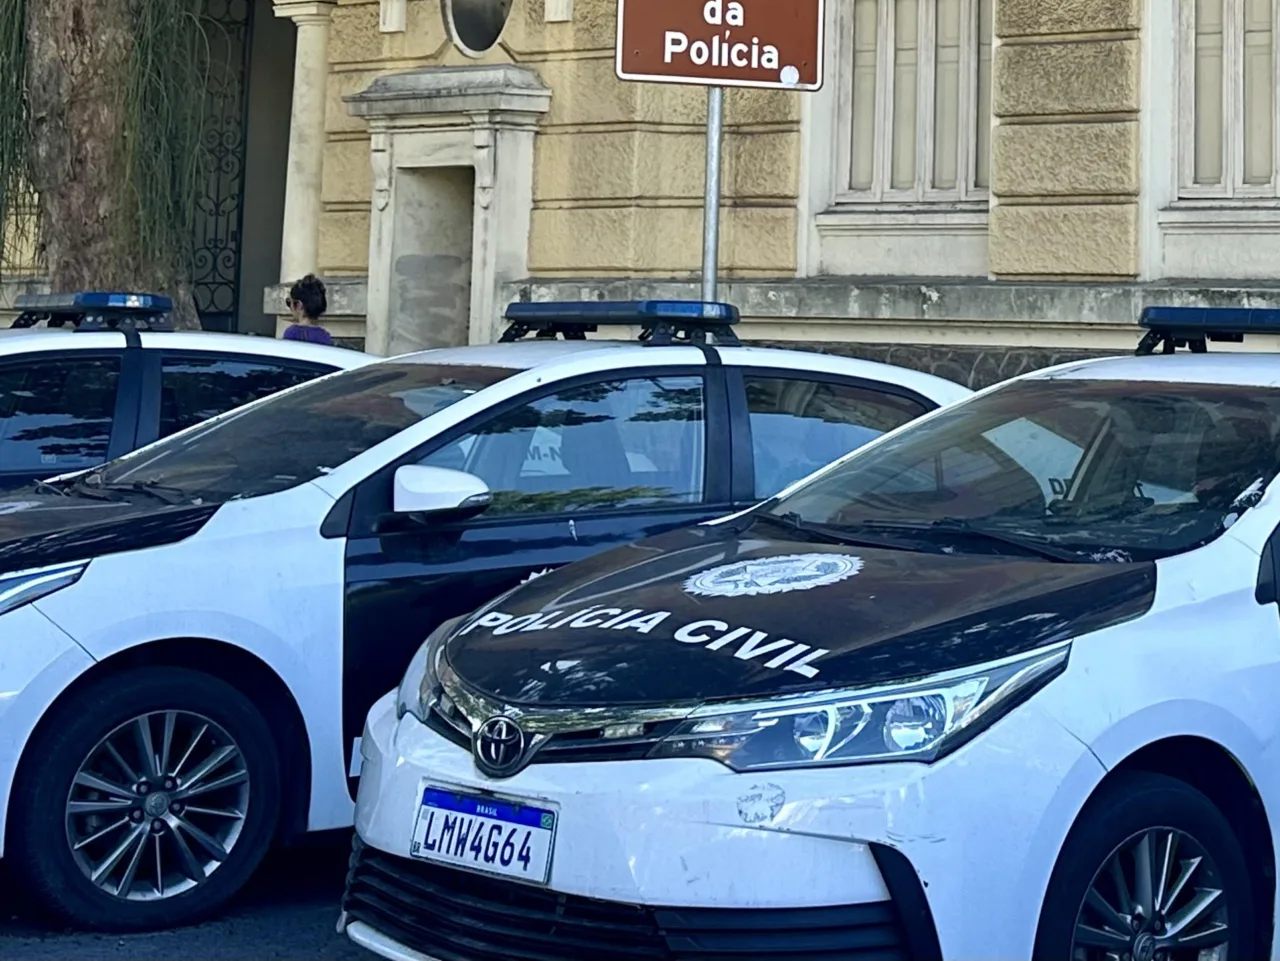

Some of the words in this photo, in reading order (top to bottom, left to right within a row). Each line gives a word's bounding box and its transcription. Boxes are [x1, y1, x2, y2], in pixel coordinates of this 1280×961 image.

[664, 30, 780, 70] Polícia
[459, 604, 672, 636] POLÍCIA
[673, 619, 830, 679] CIVIL
[476, 803, 498, 817] BRASIL
[424, 811, 532, 871] LMW4G64
